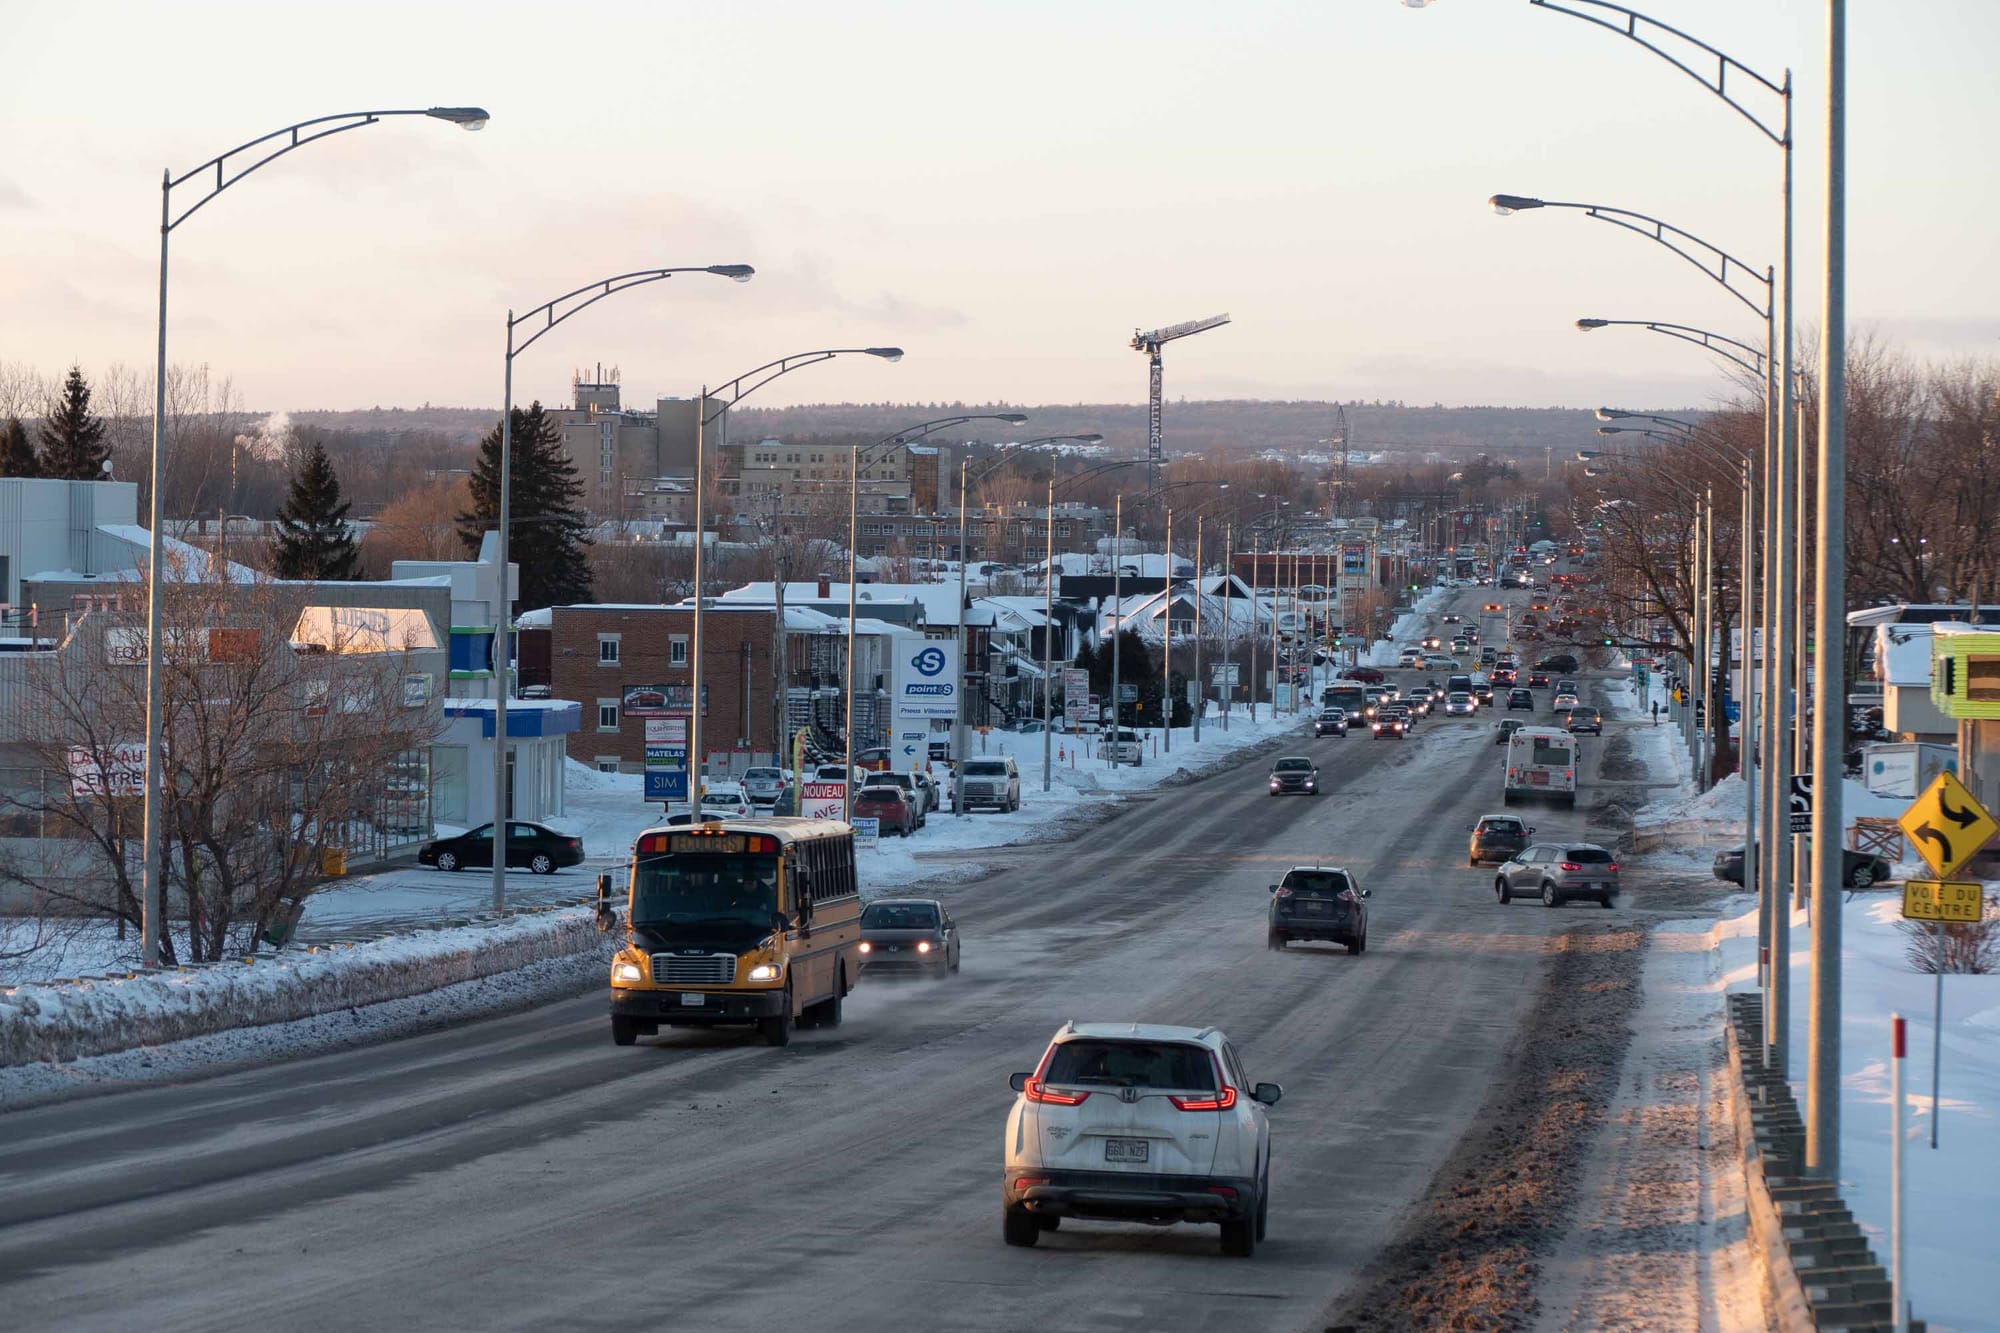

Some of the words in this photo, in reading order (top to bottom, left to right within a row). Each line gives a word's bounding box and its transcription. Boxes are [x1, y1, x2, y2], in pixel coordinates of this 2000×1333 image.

[909, 685, 938, 694] point
[647, 750, 685, 758] MATELAS
[654, 776, 678, 789] SIM
[803, 785, 844, 798] NOUVEAU
[1911, 886, 1945, 900] VOIE
[1956, 889, 1977, 901] DU
[1913, 901, 1972, 916] CENTRE
